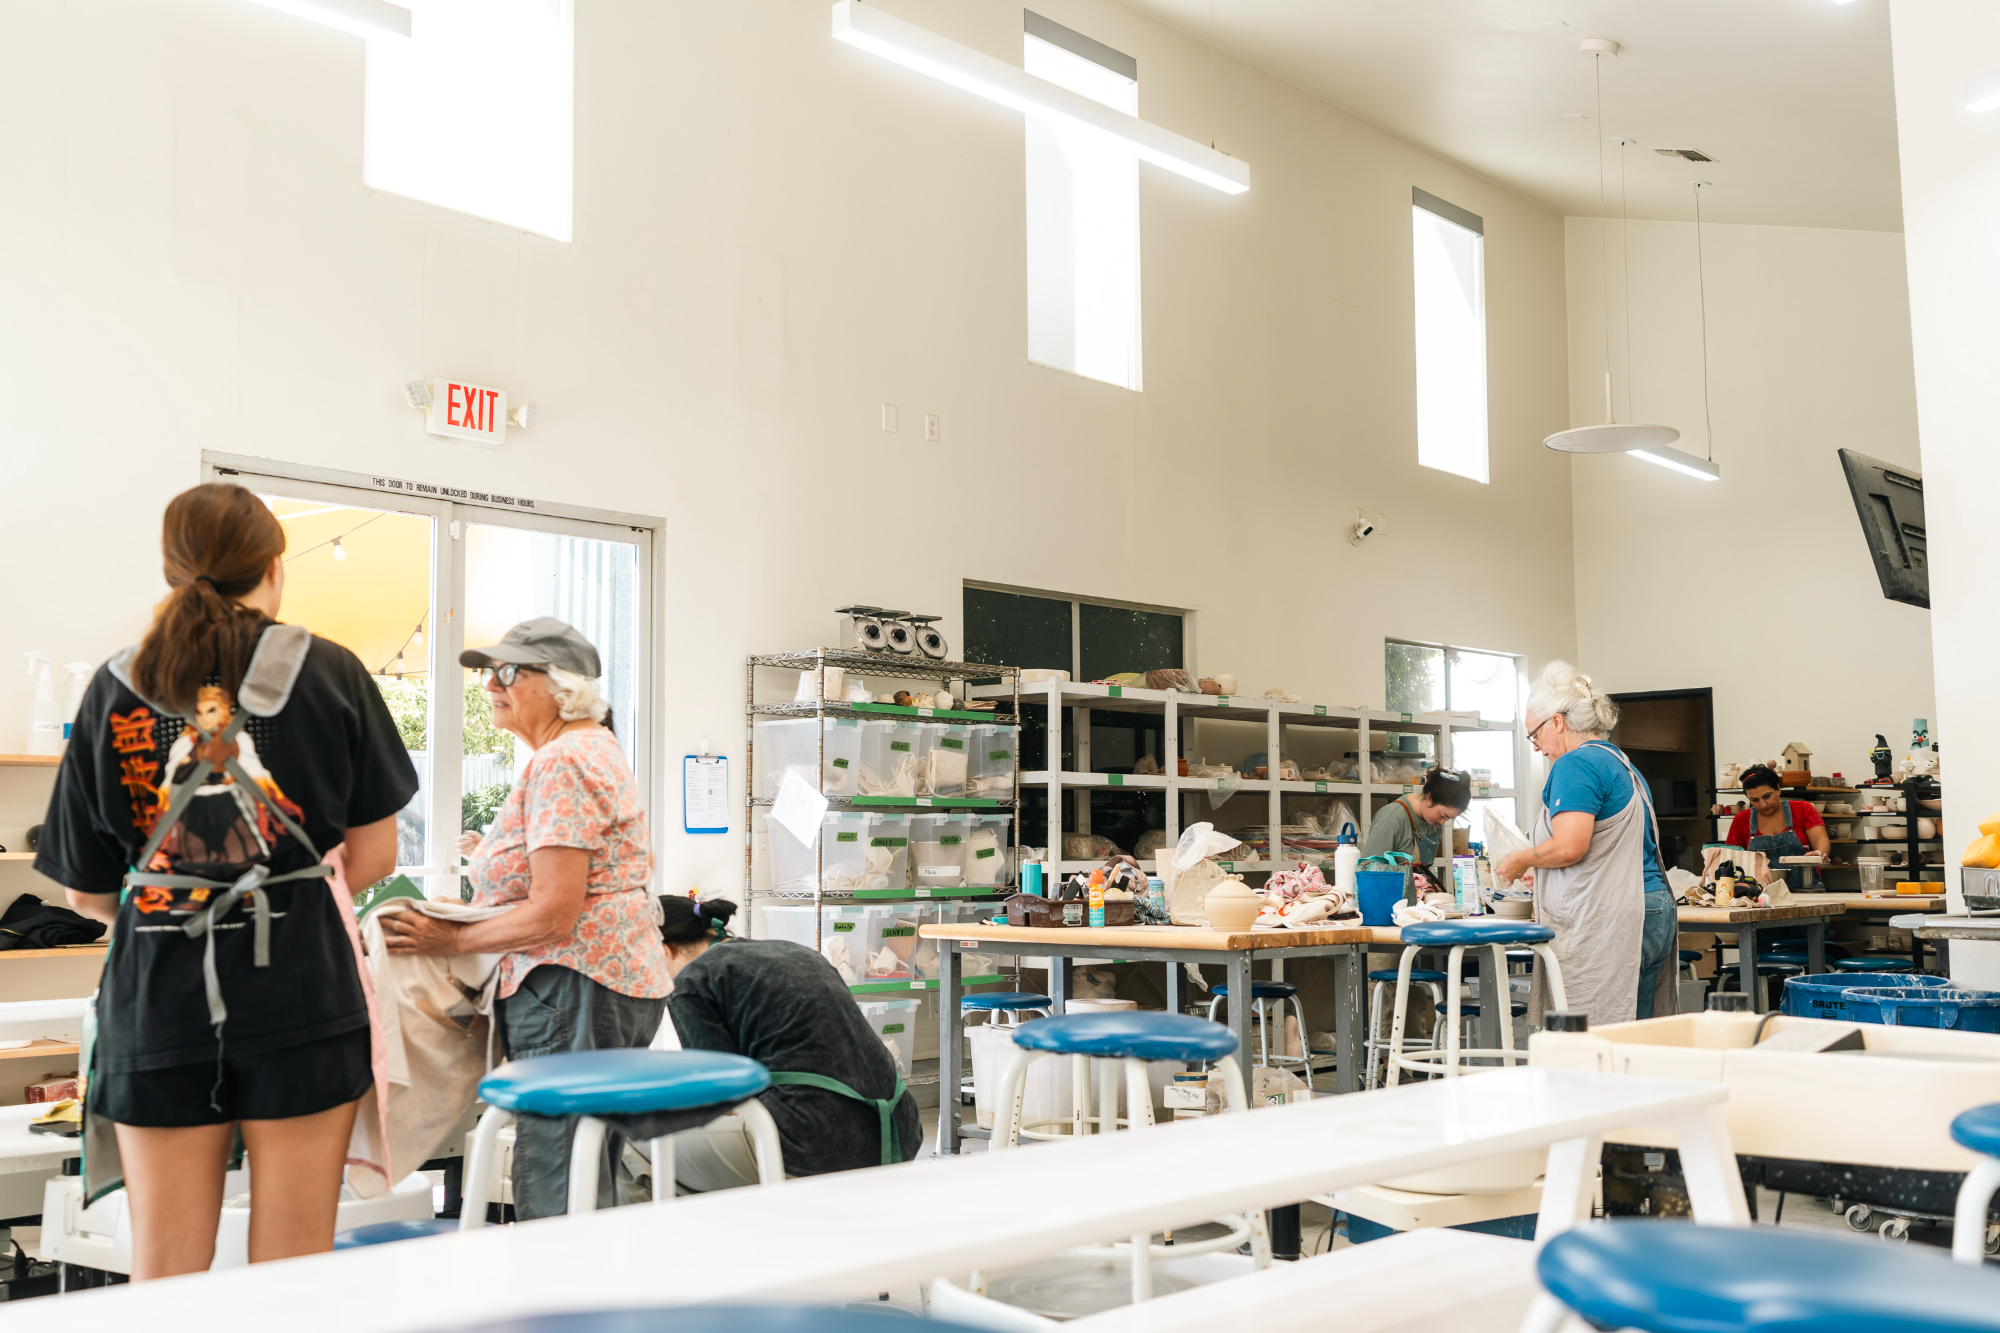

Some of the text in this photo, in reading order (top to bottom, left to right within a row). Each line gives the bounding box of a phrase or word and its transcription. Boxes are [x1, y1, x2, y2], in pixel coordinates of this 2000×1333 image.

[447, 383, 499, 432] EXIT
[372, 477, 535, 508] THIS DOOR TO REMAIN UNLOCKED DURING BUSINESS HOURS
[1812, 1000, 1847, 1010] BRUTE
